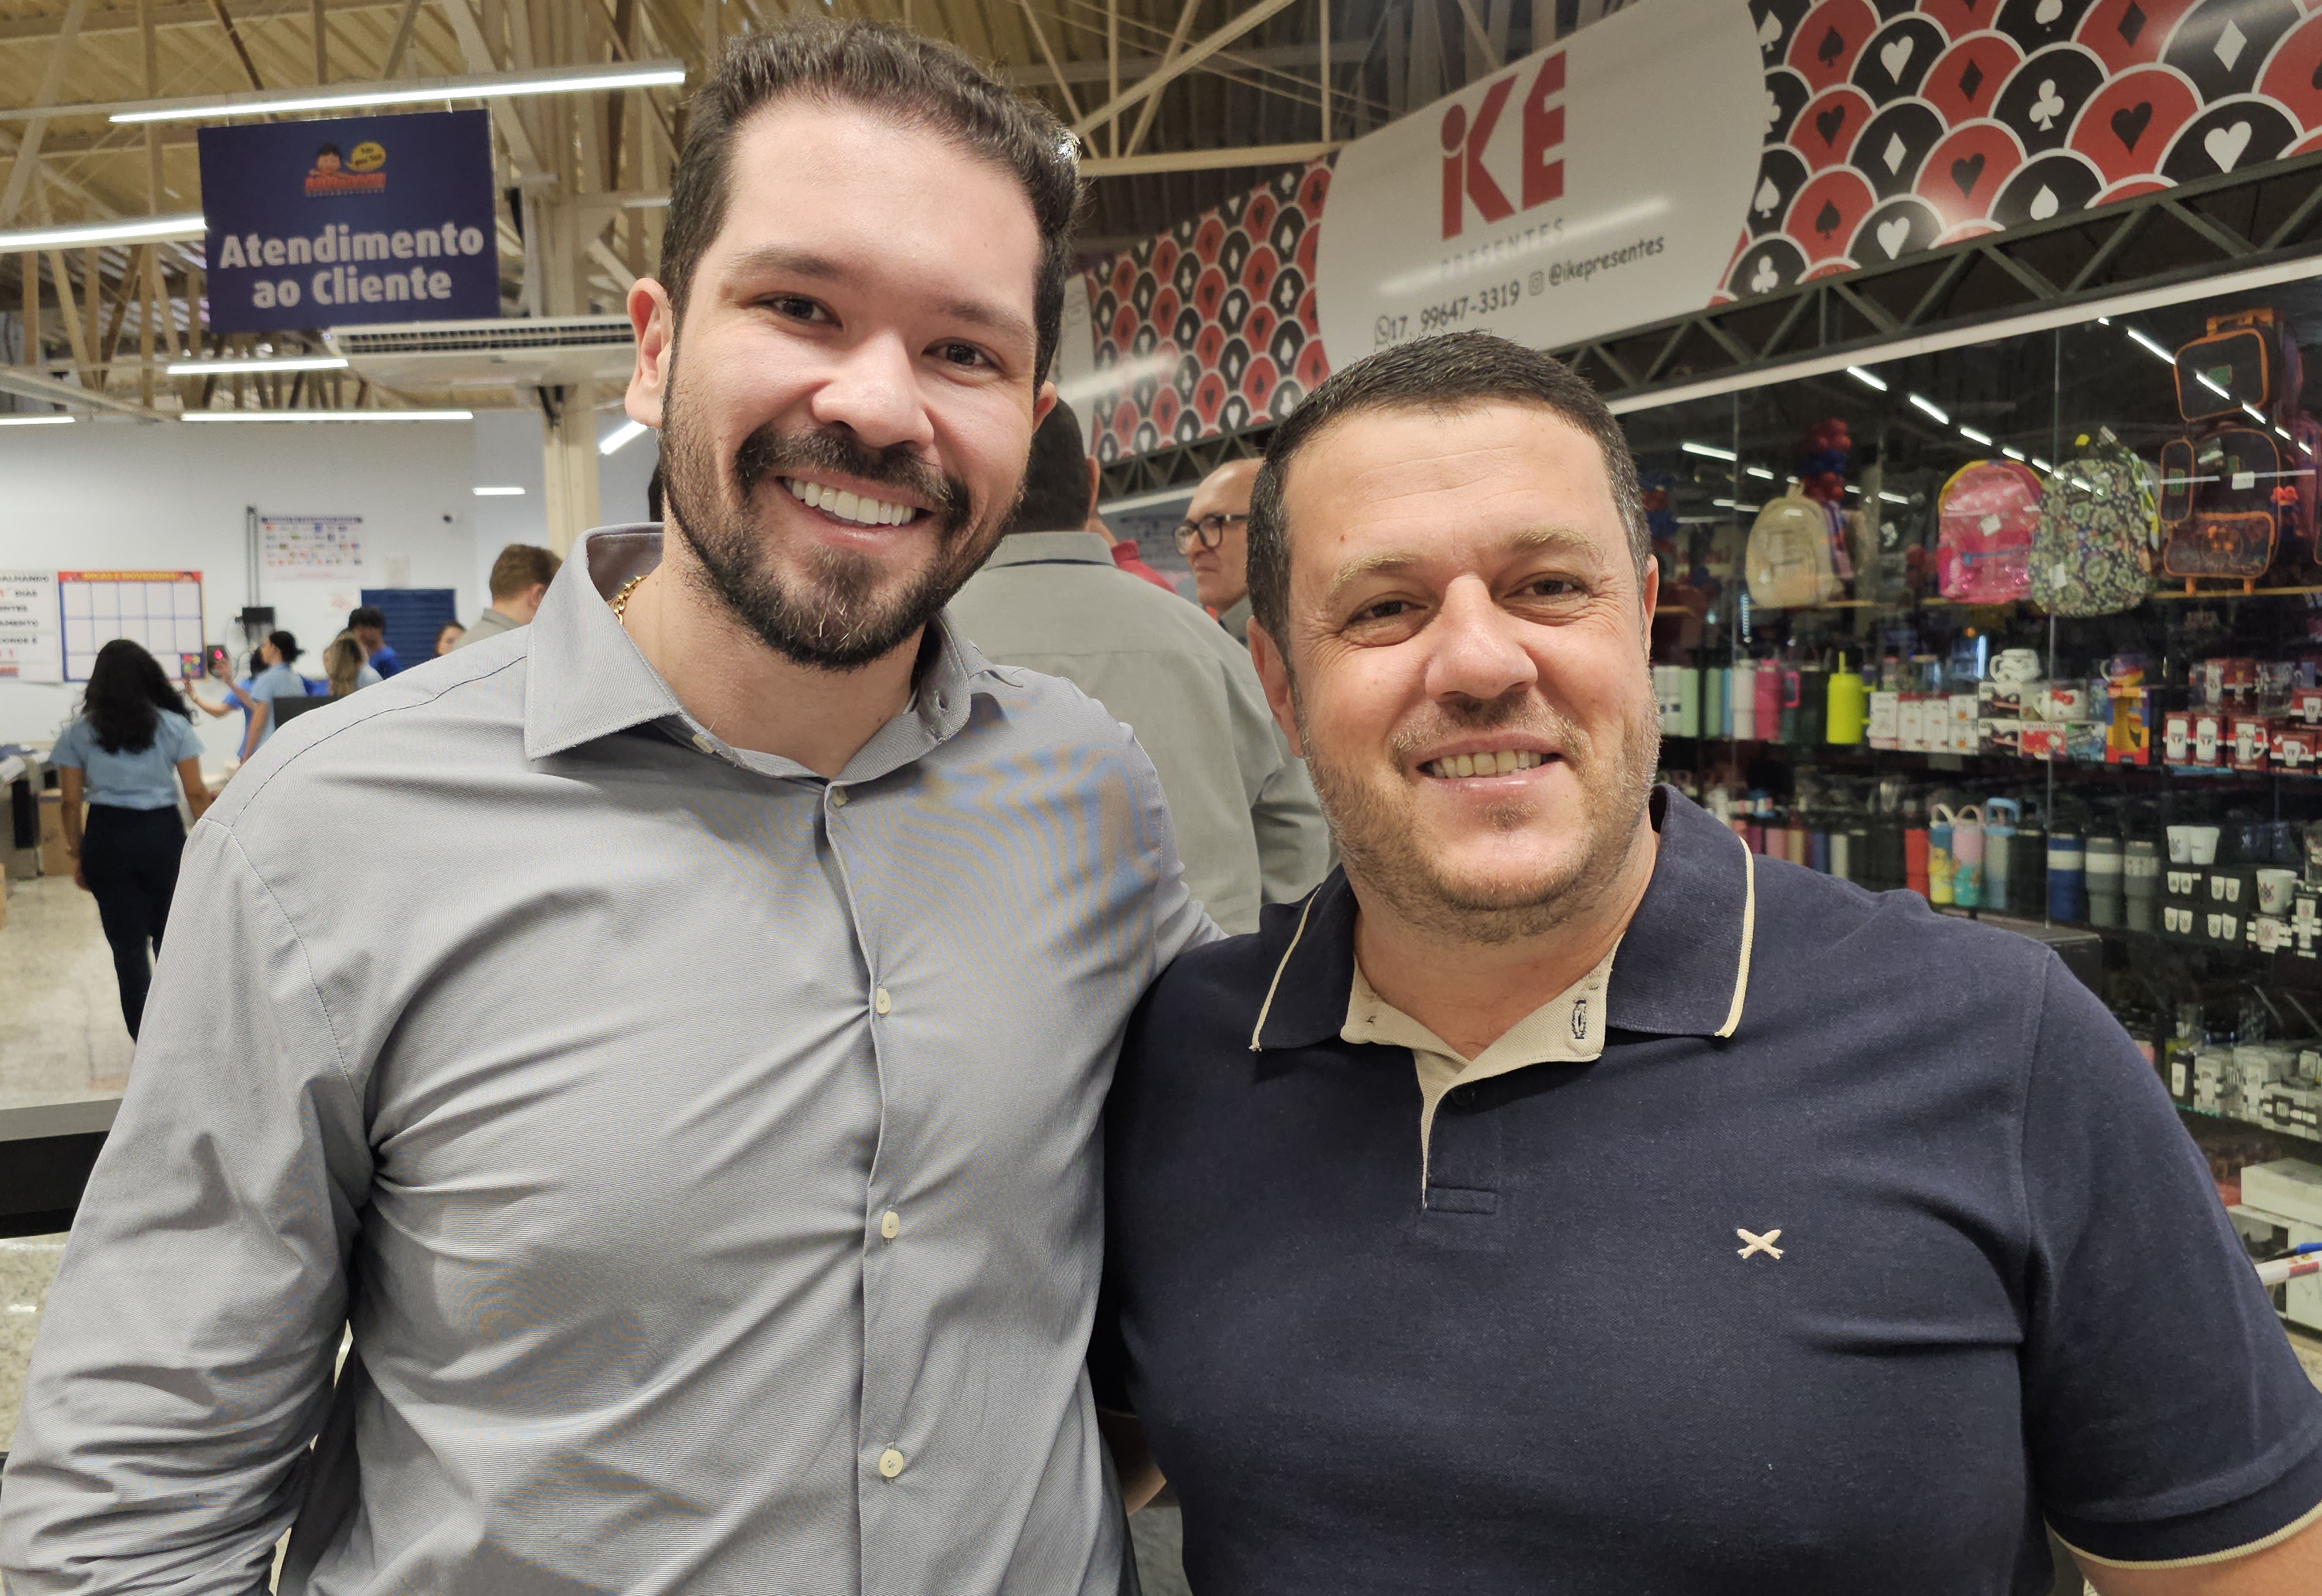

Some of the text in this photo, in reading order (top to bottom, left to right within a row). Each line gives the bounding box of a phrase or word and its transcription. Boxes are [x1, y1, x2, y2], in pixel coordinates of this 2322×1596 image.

[218, 221, 485, 269] Atendimento
[252, 265, 452, 309] ao Cliente
[1420, 280, 1520, 332] 99647-3319
[1549, 235, 1664, 287] @ikepresentes
